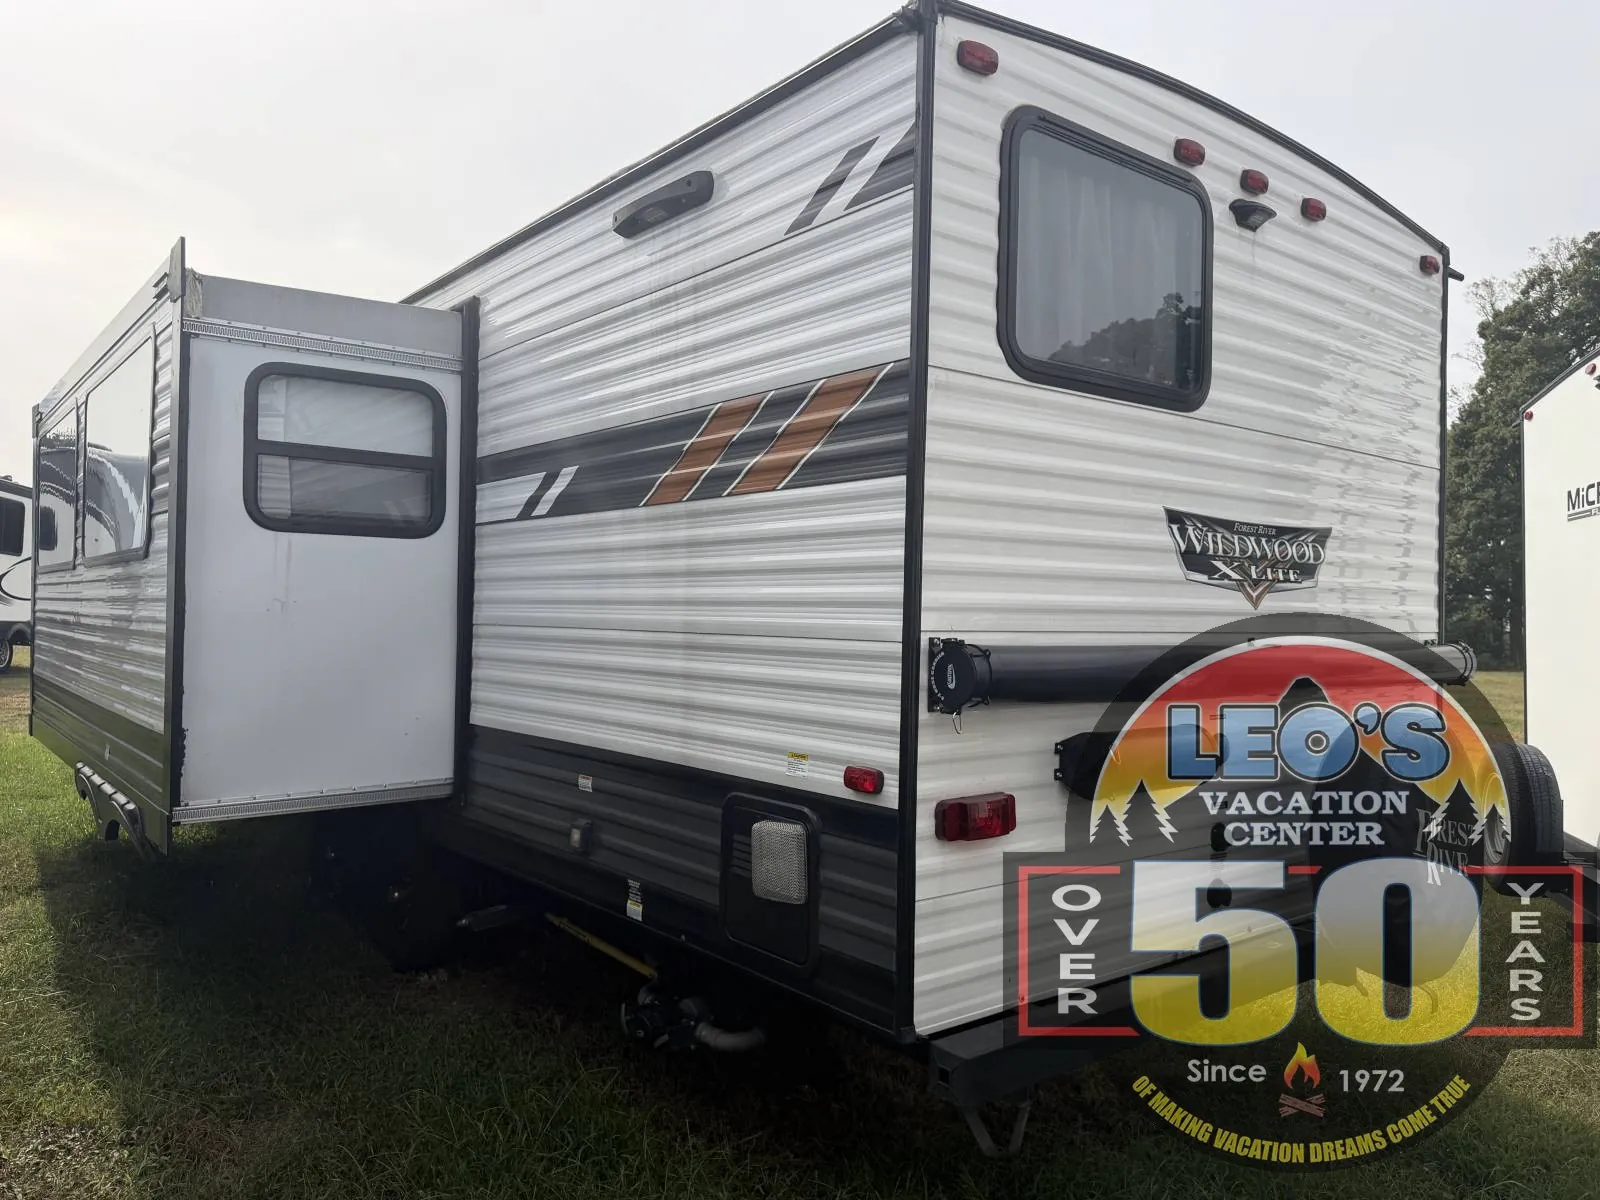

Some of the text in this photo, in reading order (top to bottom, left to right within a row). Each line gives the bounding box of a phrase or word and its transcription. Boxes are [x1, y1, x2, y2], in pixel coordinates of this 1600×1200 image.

[1234, 522, 1276, 535] FOREST RIVER
[1168, 523, 1326, 564] WILDWOOD
